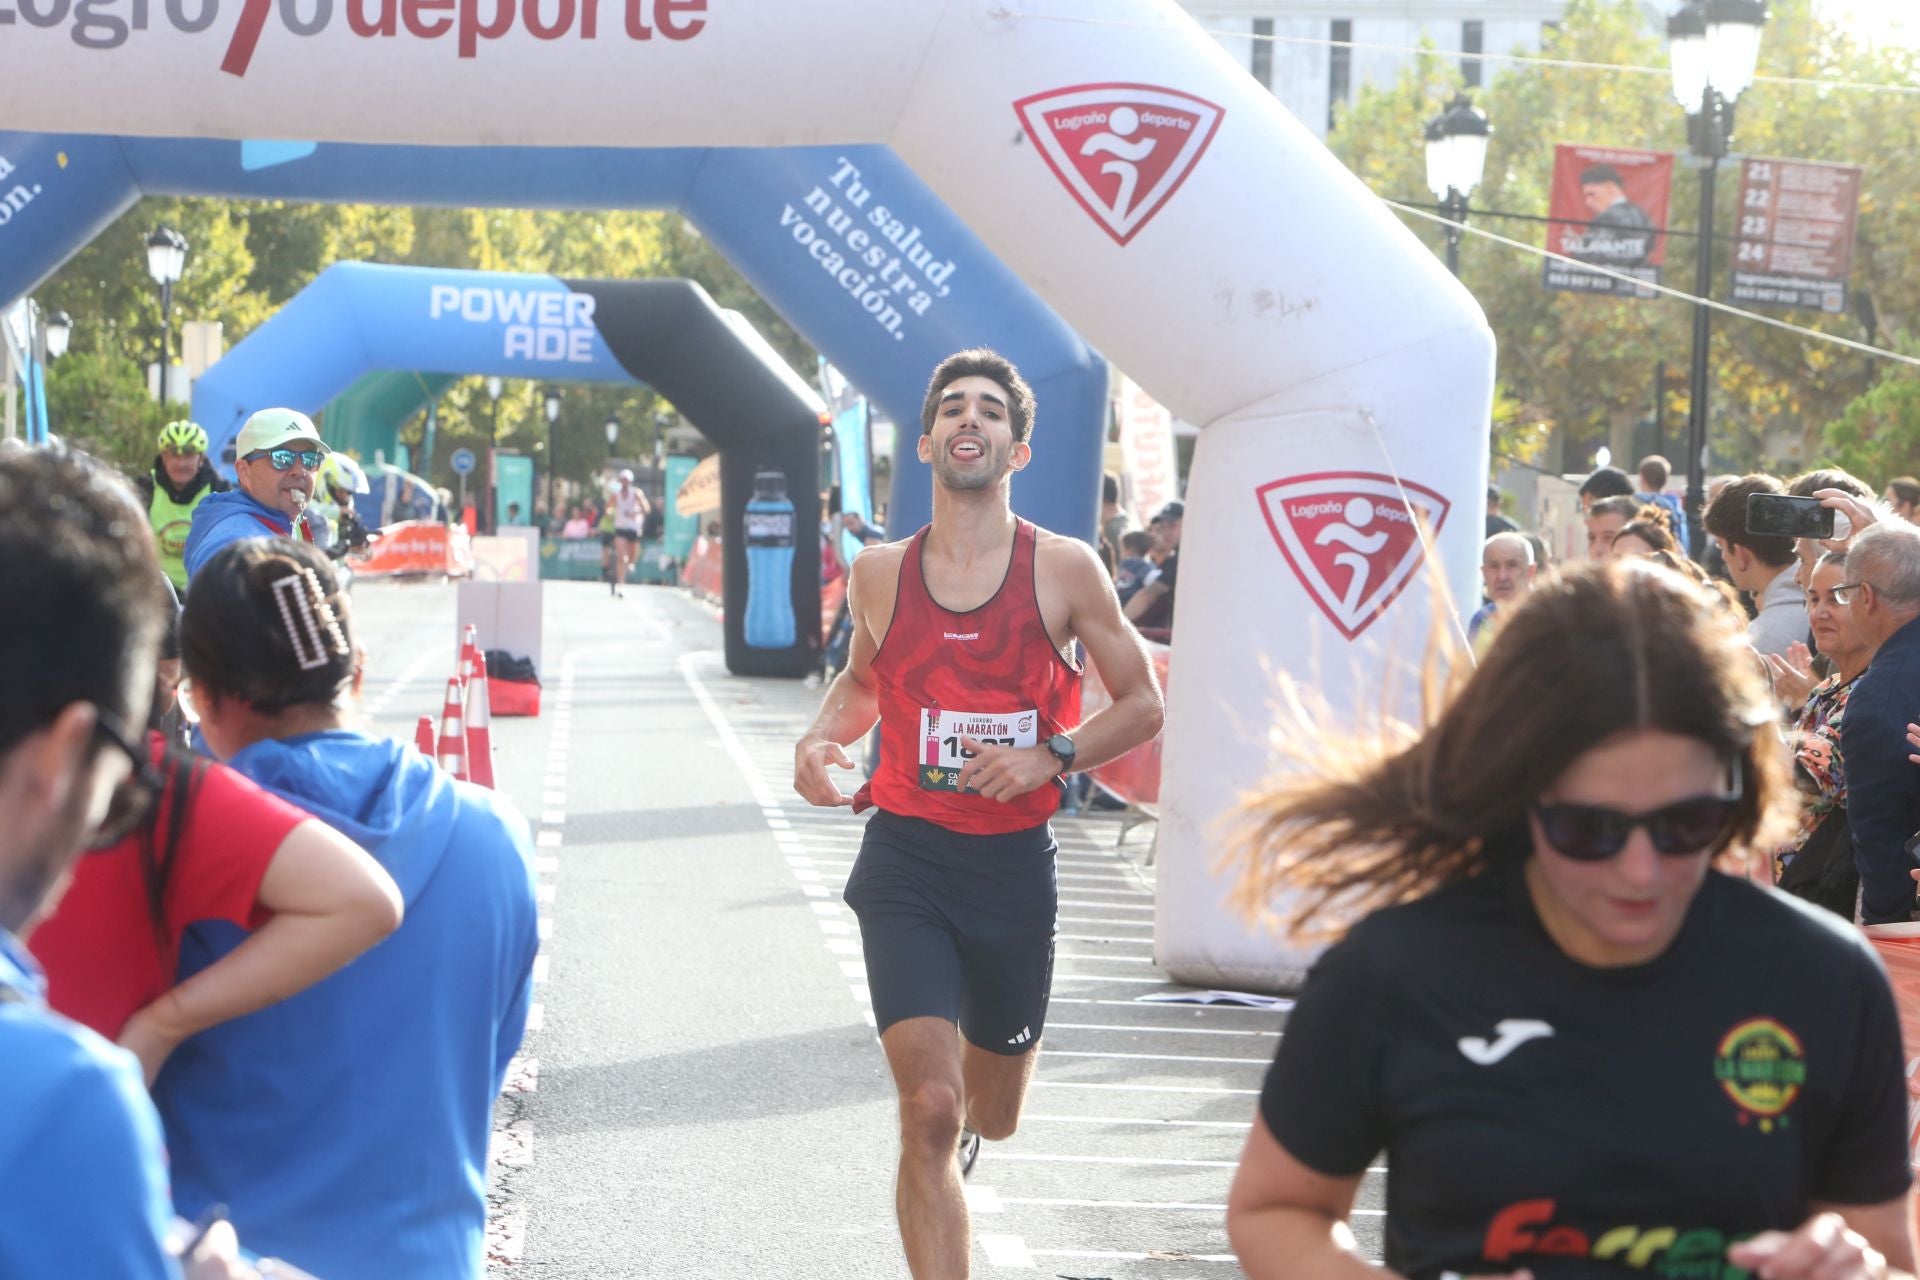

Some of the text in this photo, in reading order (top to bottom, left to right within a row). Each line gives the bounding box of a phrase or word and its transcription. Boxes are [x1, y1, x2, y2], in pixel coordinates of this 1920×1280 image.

[1054, 111, 1192, 131] Logroño deporte
[1748, 161, 1771, 180] 21
[1744, 188, 1770, 208] 22
[828, 155, 957, 298] Tu salud,
[803, 185, 932, 317] nuestra
[1737, 241, 1764, 260] 24
[779, 203, 905, 341] vocación.
[429, 284, 597, 328] POWER
[504, 324, 595, 363] ADE
[1291, 501, 1343, 518] Logroño
[953, 722, 964, 734] LA
[967, 723, 1008, 736] MARATÓN
